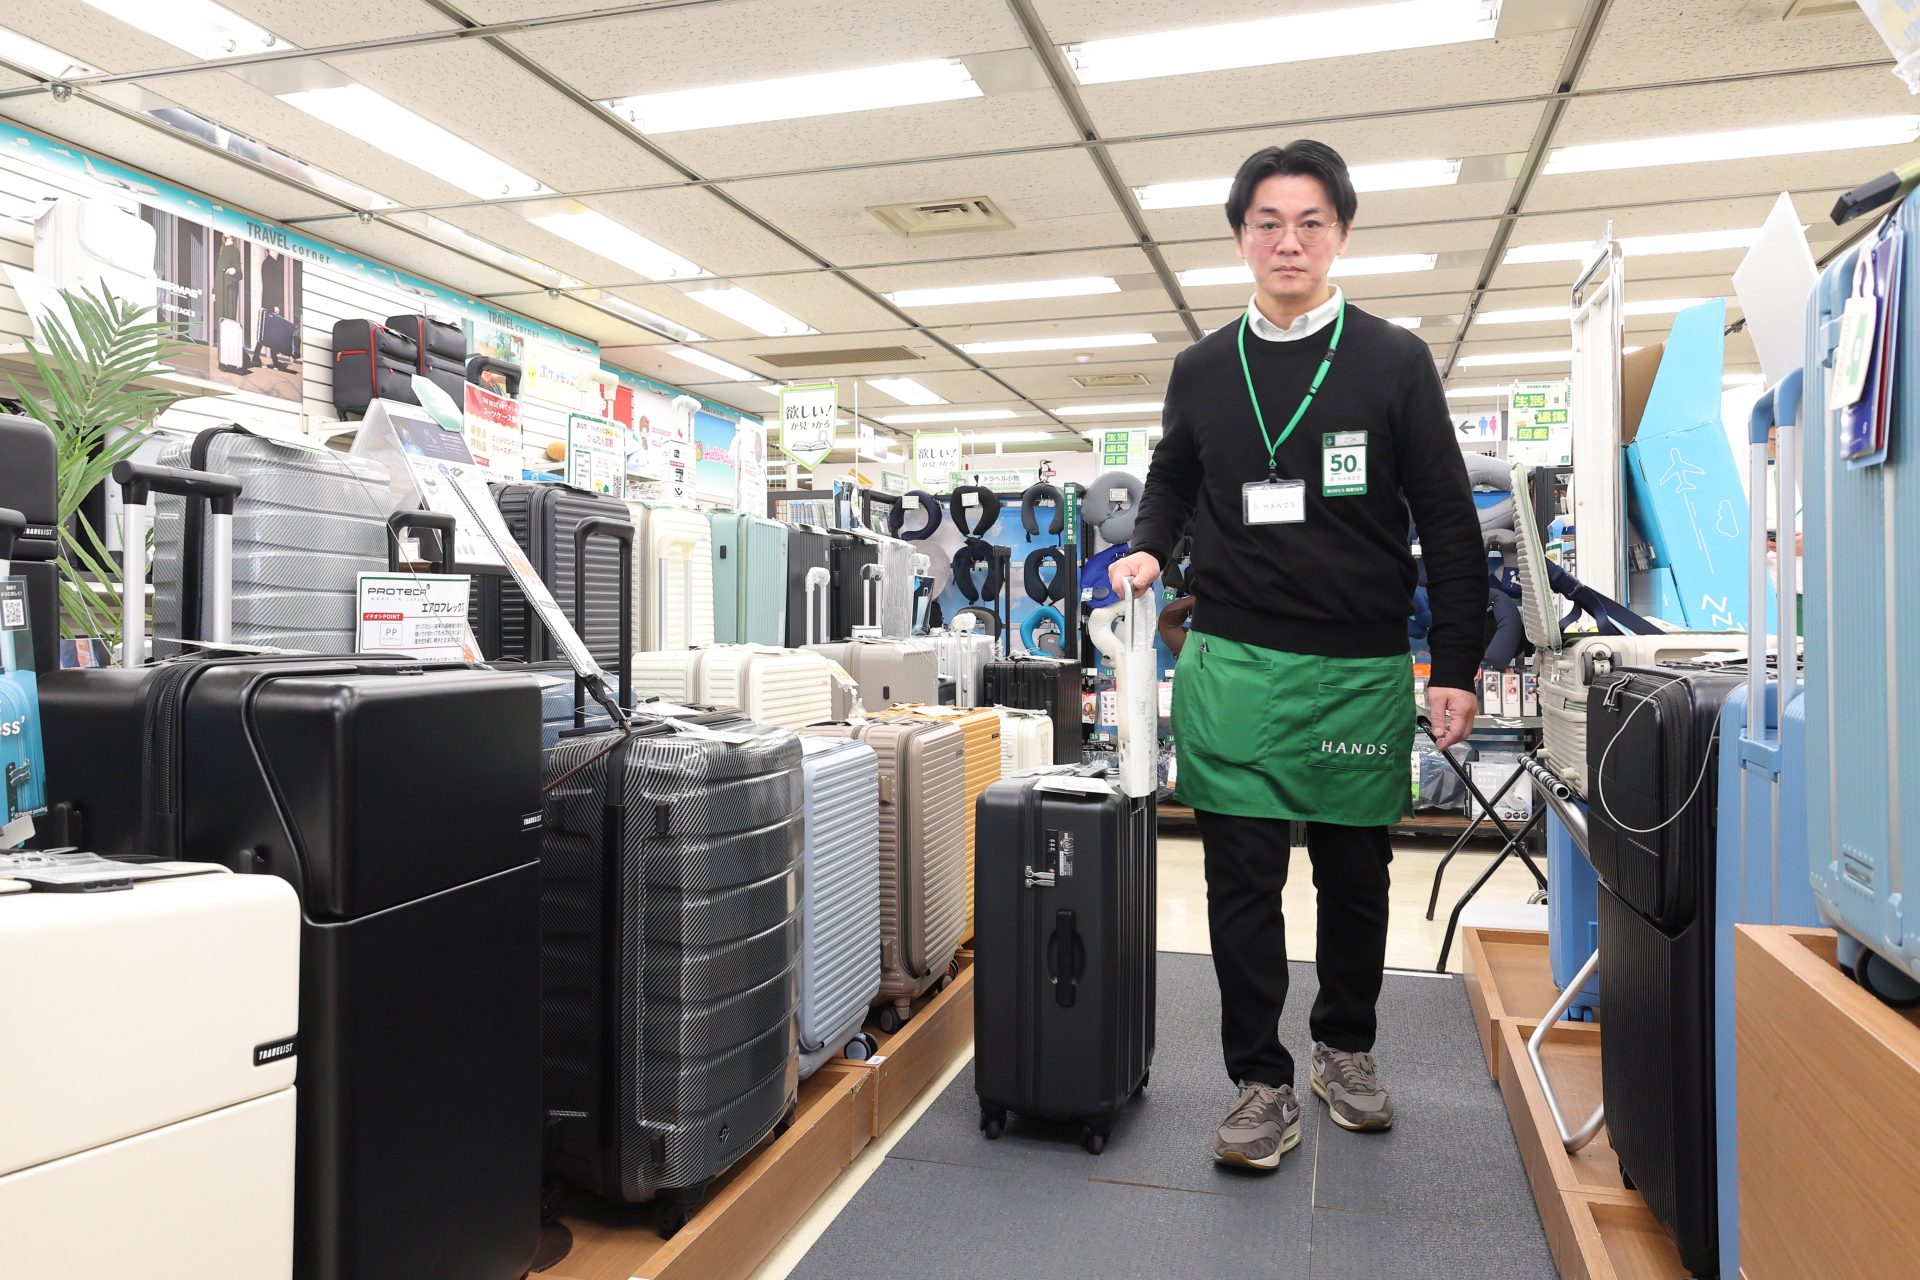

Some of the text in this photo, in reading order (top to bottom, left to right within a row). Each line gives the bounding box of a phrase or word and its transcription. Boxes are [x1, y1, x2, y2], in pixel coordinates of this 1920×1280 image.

[247, 221, 331, 265] TRAVEL corner
[162, 302, 190, 316] HERITAGE
[488, 310, 540, 339] TRAVEL corner
[1515, 395, 1544, 407] 生活
[786, 404, 832, 420] 欲しい！
[791, 420, 831, 431] が見つかる
[918, 448, 957, 460] 欲しい！
[922, 460, 955, 468] が見つかる
[386, 628, 398, 637] PP
[1321, 740, 1388, 755] HANDS
[19, 806, 48, 818] Patent pending
[259, 1042, 294, 1060] TRAVELIST
